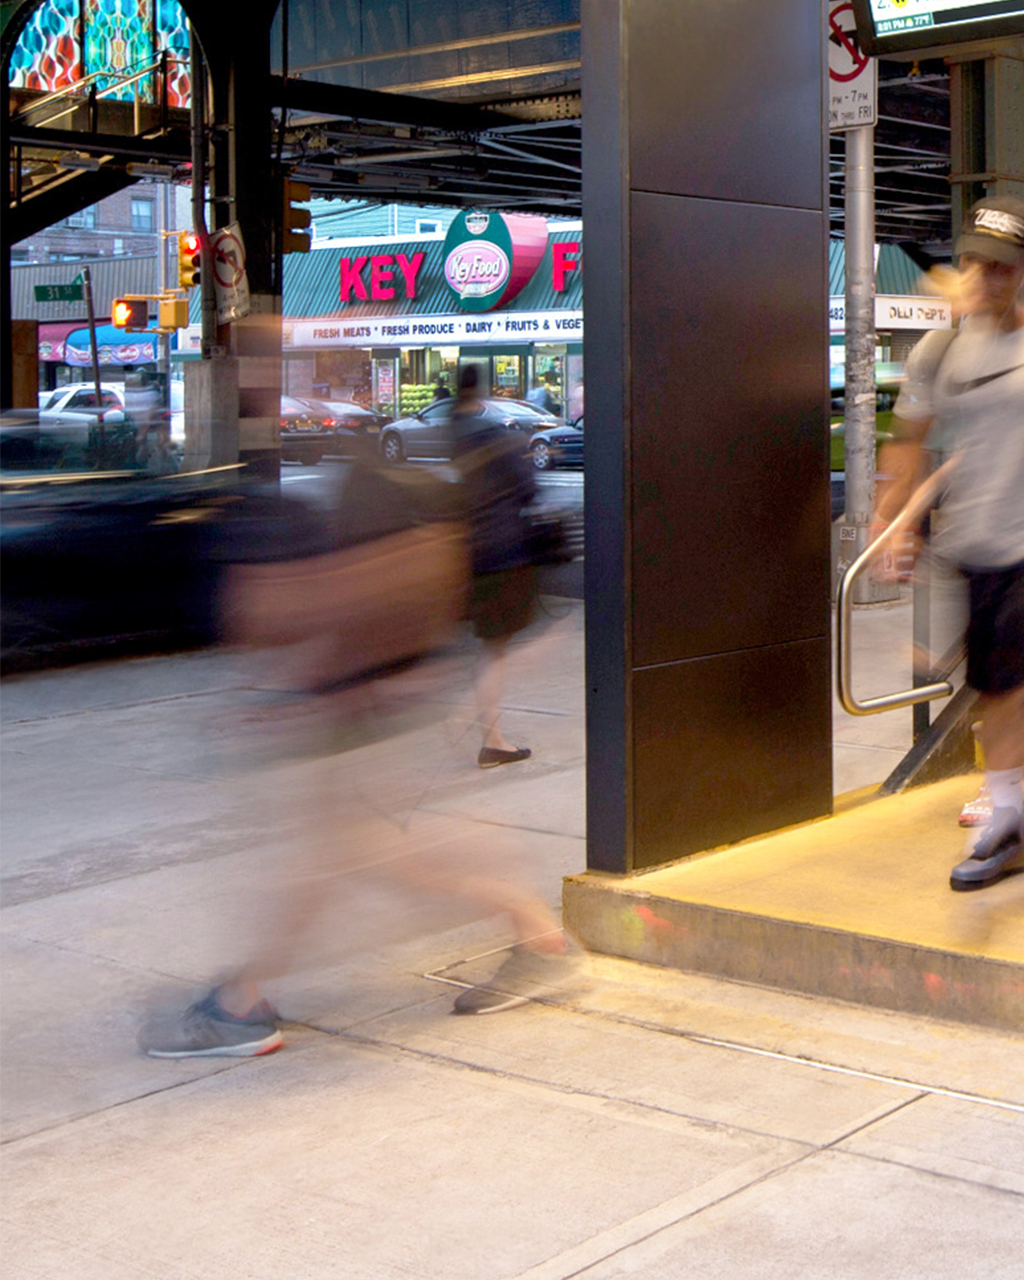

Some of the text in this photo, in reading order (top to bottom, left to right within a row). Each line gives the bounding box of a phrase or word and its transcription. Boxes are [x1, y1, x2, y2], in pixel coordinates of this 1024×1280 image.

[892, 19, 905, 29] PM
[858, 105, 872, 118] FRI
[339, 242, 579, 302] KEY F
[47, 286, 60, 300] 31
[313, 328, 340, 339] FRESH
[343, 326, 371, 338] MEATS
[382, 325, 410, 336] FRESH
[412, 323, 455, 335] PRODUCE
[465, 321, 493, 333] DAIRY
[505, 319, 539, 332] FRUITS
[543, 320, 550, 330] &
